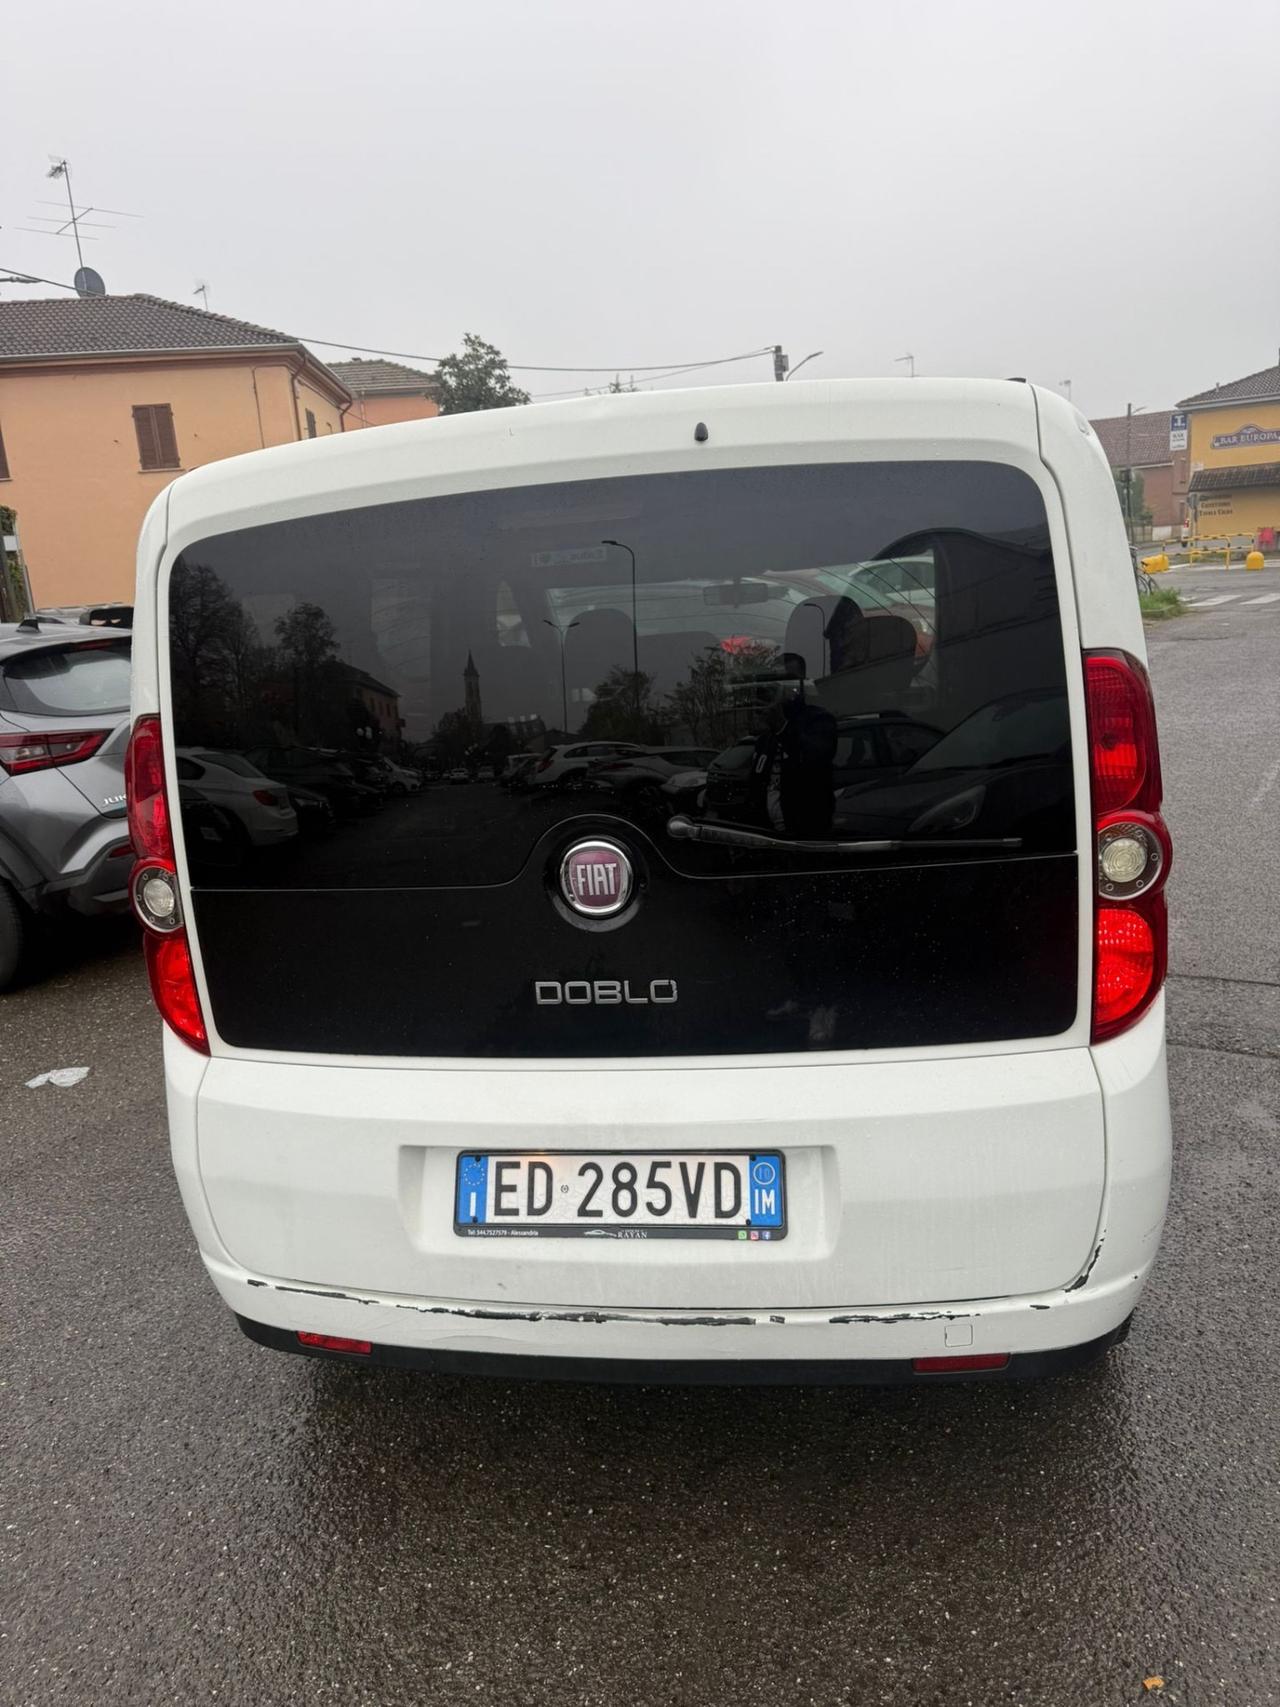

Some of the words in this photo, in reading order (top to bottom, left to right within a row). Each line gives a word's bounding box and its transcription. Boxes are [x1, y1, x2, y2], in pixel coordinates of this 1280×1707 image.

[1220, 436, 1239, 444] BAR
[1240, 431, 1278, 441] EUROPA
[102, 794, 127, 806] JUK
[576, 863, 617, 896] FIAT
[535, 979, 678, 1005] DOBLO
[494, 1161, 553, 1217] ED
[577, 1161, 742, 1218] 285VD
[754, 1189, 776, 1215] IM
[469, 1192, 476, 1216] I
